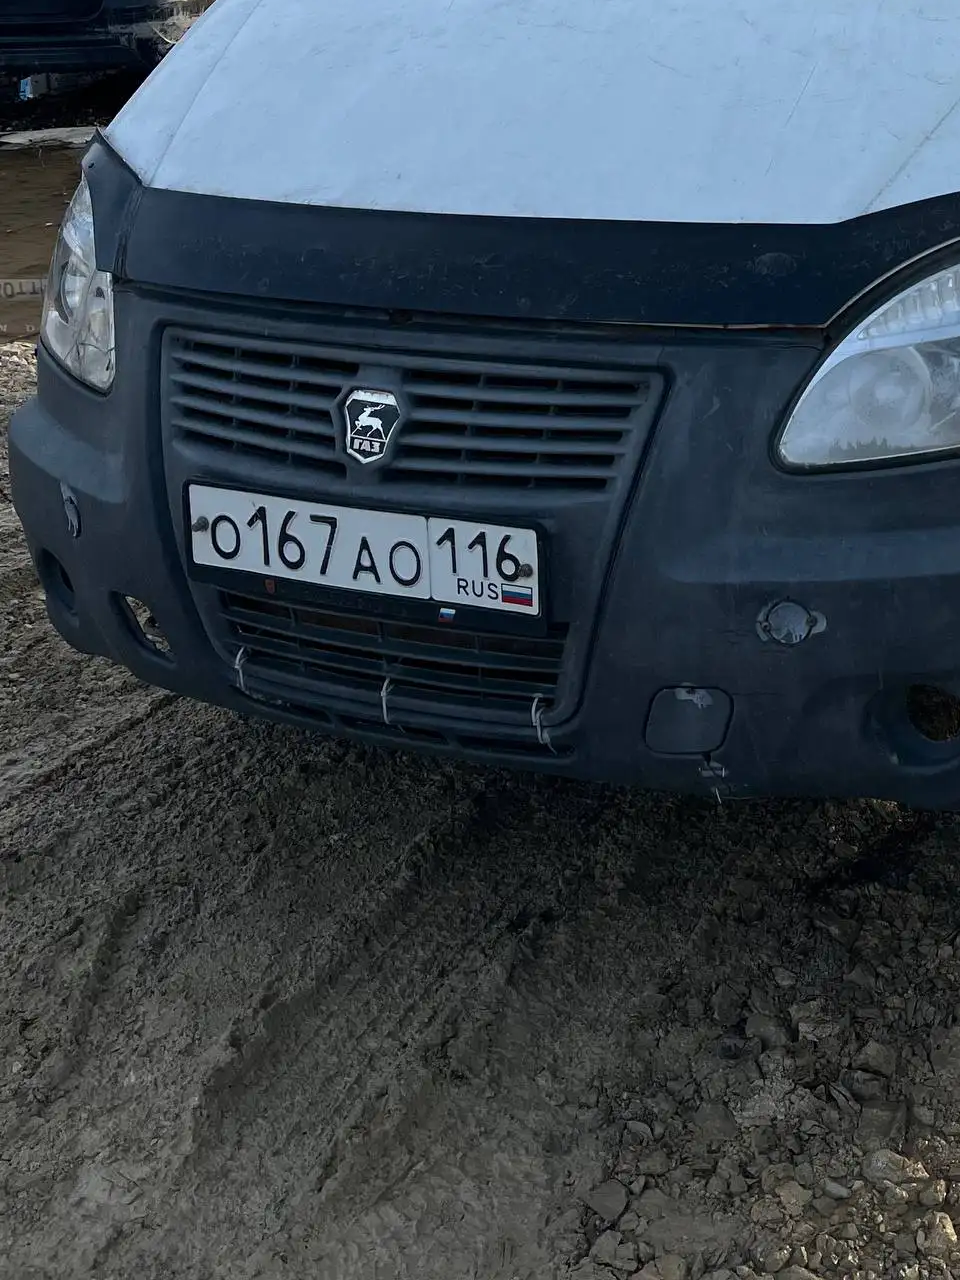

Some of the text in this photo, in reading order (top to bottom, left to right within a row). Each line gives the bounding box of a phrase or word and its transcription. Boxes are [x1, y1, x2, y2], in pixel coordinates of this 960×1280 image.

[353, 438, 381, 453] ГАЗ
[436, 527, 522, 582] 116
[456, 577, 499, 601] RUS
